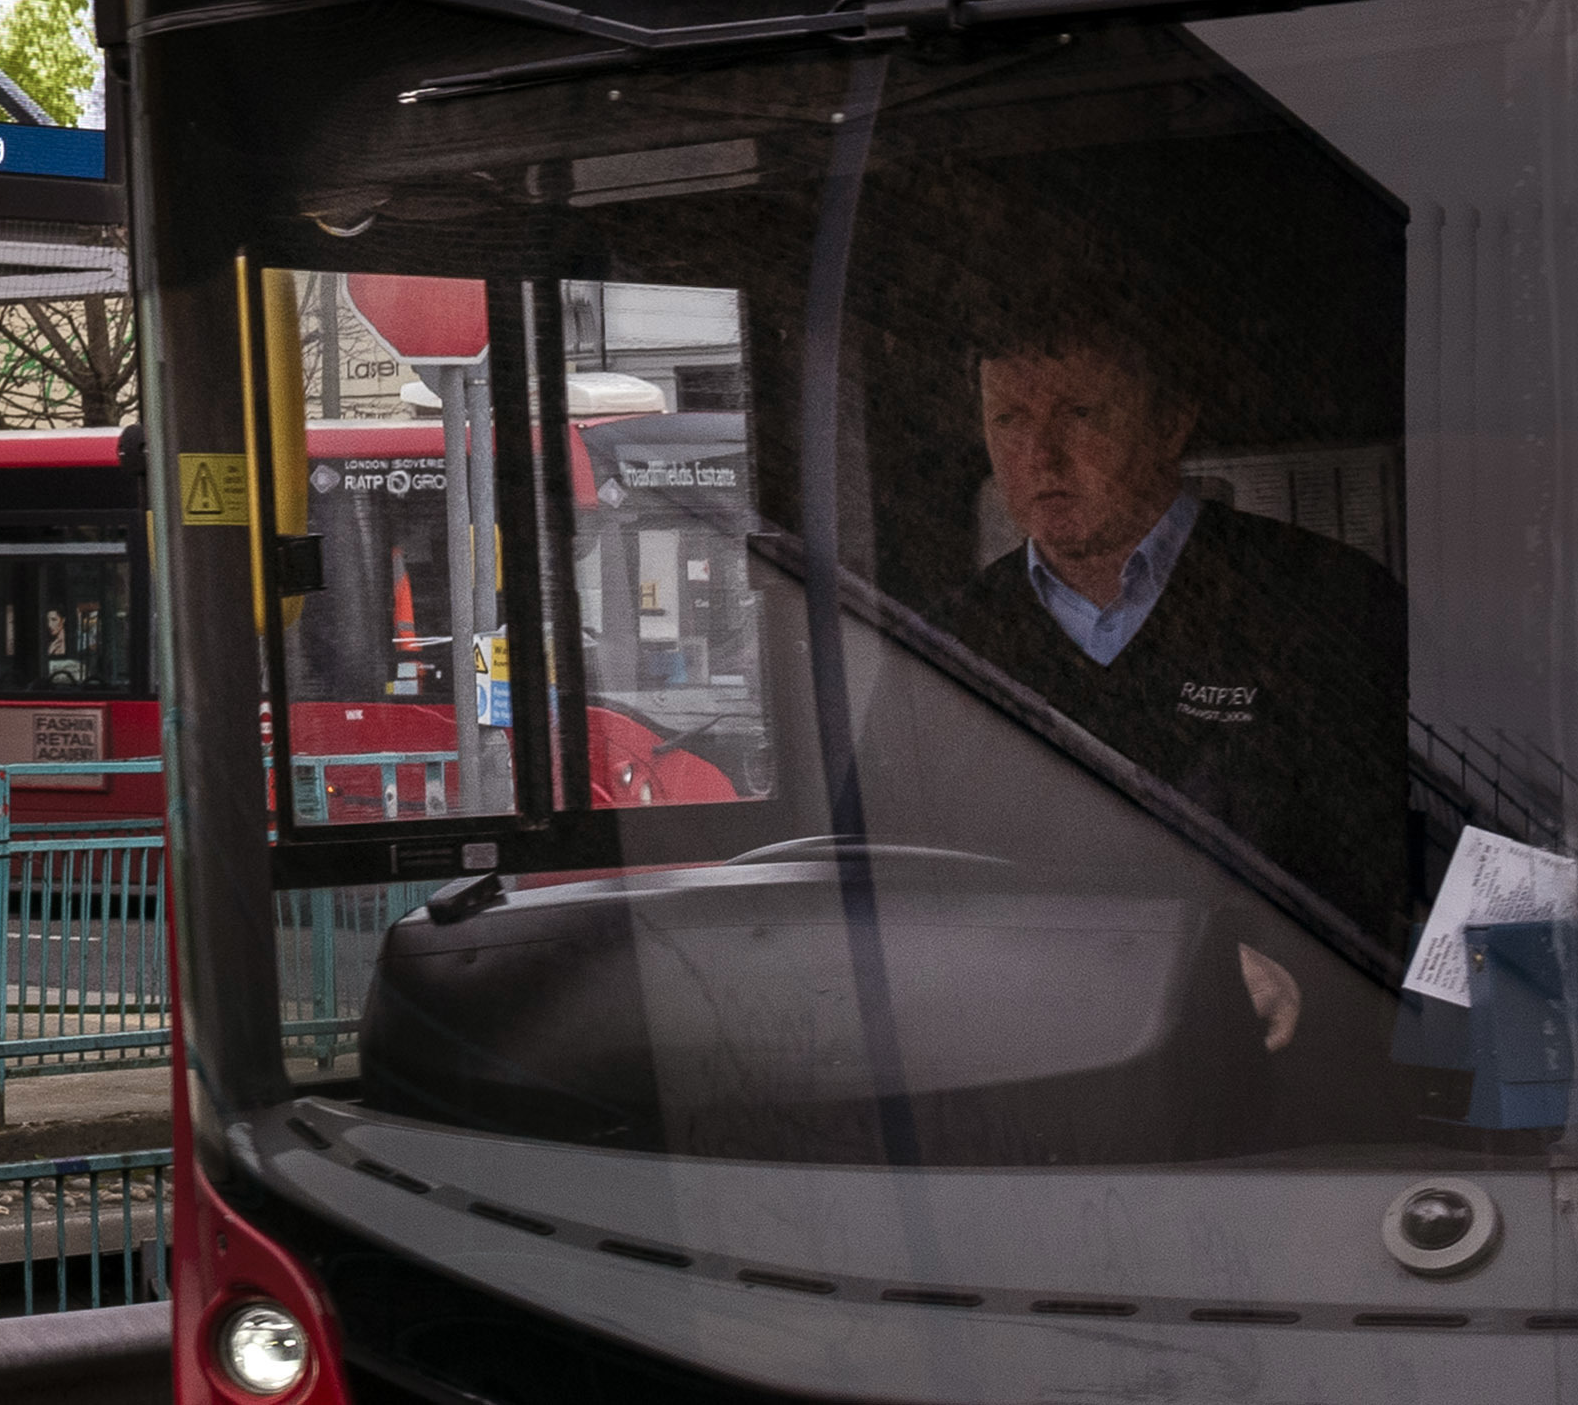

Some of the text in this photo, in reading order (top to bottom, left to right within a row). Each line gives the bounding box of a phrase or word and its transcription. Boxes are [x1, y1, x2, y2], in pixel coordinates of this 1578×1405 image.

[347, 360, 399, 379] Laser
[345, 460, 388, 470] LONDON
[345, 475, 384, 490] RATP
[37, 732, 94, 746] RETAIL
